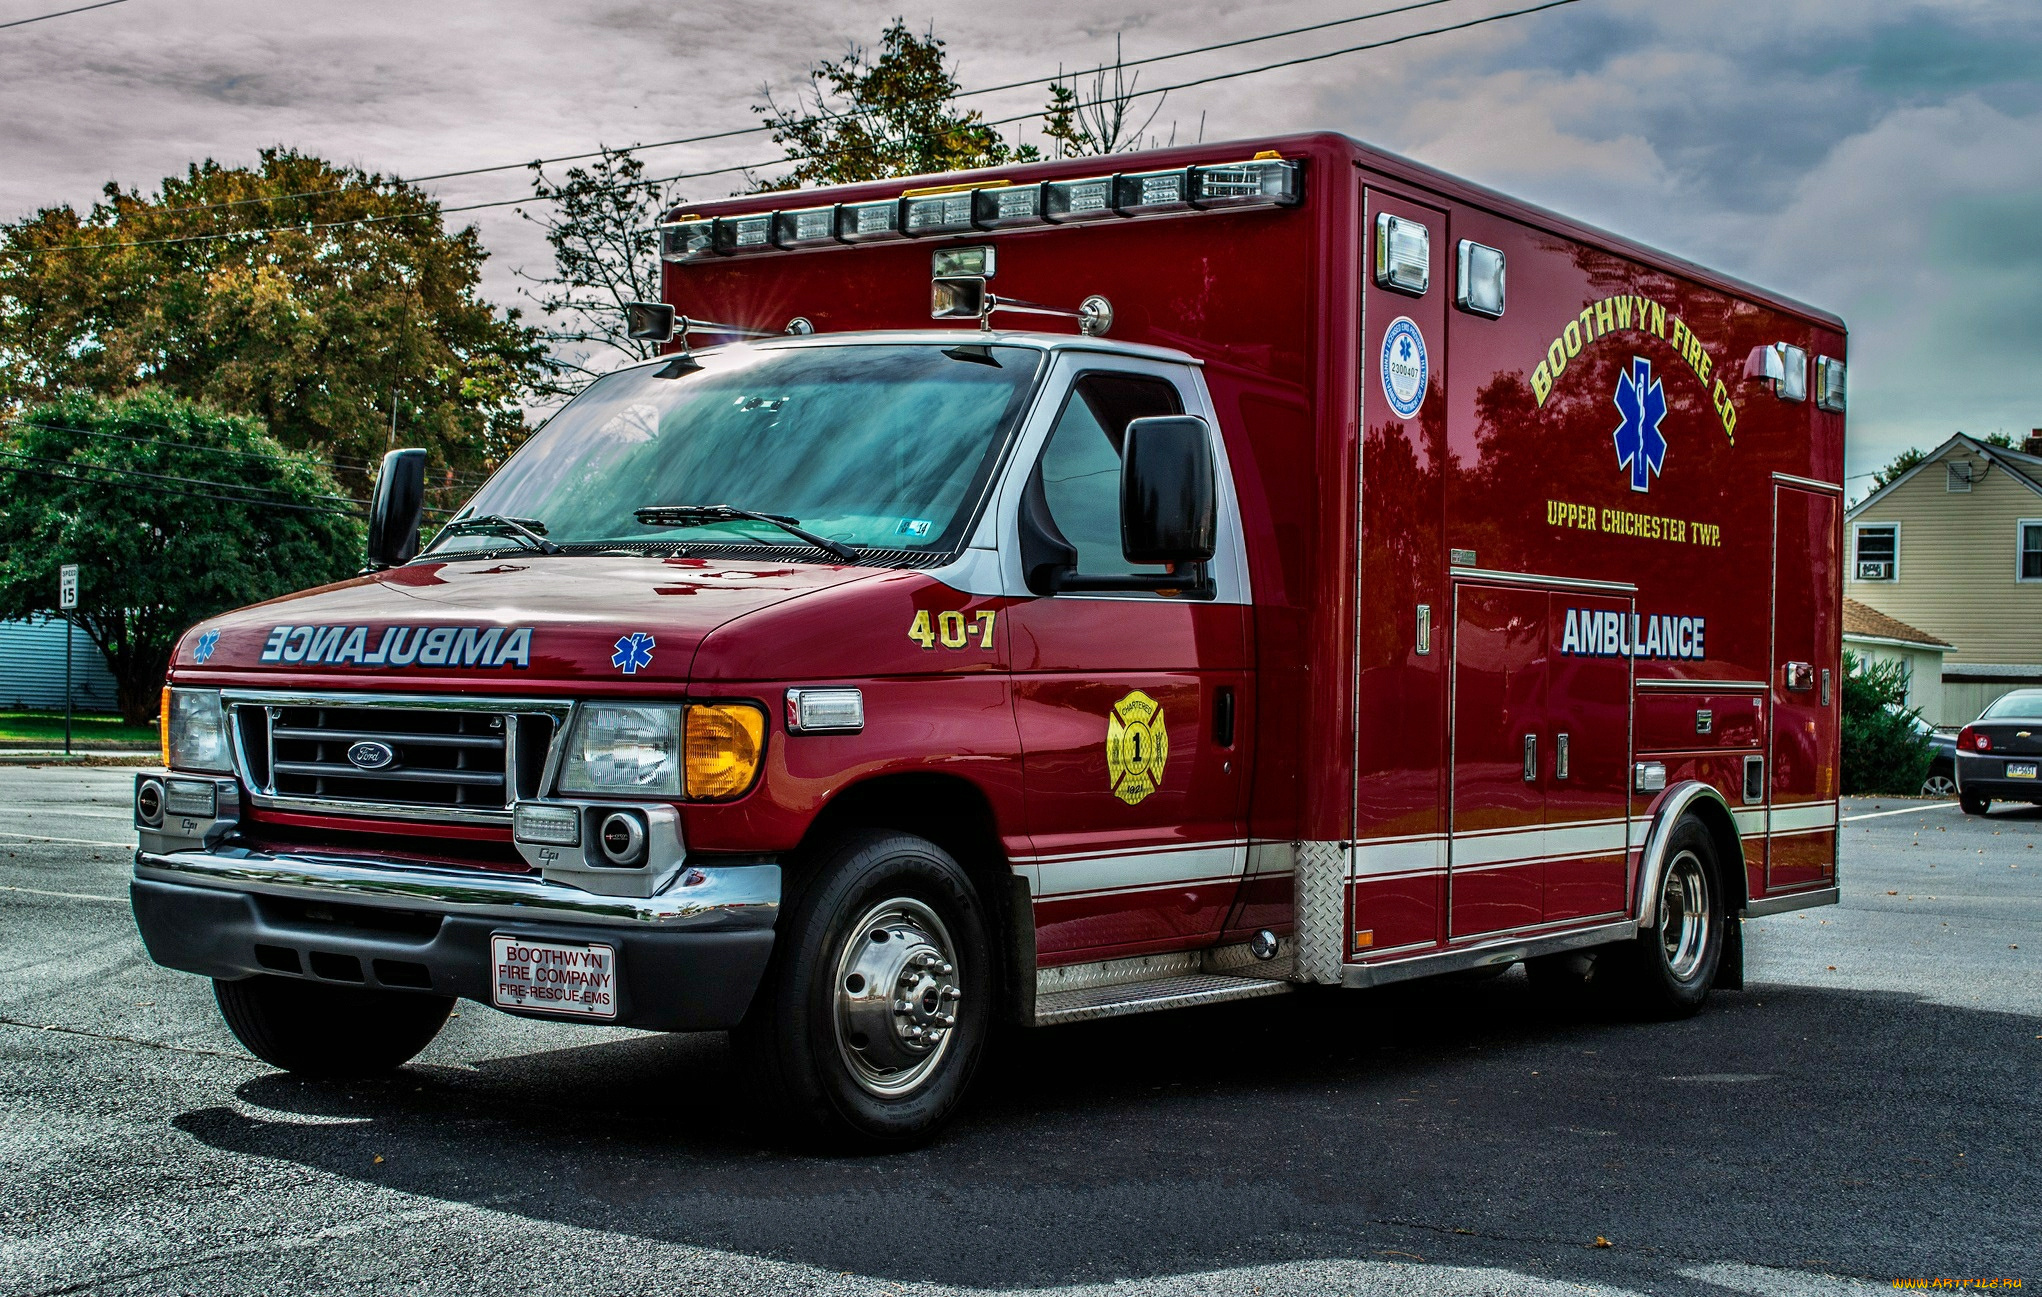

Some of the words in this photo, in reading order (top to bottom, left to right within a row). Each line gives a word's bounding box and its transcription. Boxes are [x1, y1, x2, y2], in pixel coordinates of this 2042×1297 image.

[1392, 362, 1419, 378] 2300407
[1530, 295, 1666, 409] BOOTHWYN
[1672, 316, 1713, 389] FIRE
[1713, 379, 1737, 448] CO.
[1547, 500, 1596, 531] UPPER
[1601, 508, 1686, 543] CHICHESTER
[1691, 521, 1721, 547] TWP.
[63, 578, 75, 586] LIMIT
[63, 587, 75, 604] 15
[907, 609, 996, 649] 40-7
[1561, 607, 1706, 661] AMBULANCE
[1121, 700, 1153, 716] CHARTERED
[356, 746, 380, 761] Ford
[1132, 732, 1142, 762] 1
[1127, 784, 1143, 794] 1921
[506, 946, 603, 969] BOOTHWYN
[499, 964, 531, 981] FIRE
[536, 967, 611, 988] COMPANY
[500, 983, 610, 1005] FIRE-RESCUE-EMS
